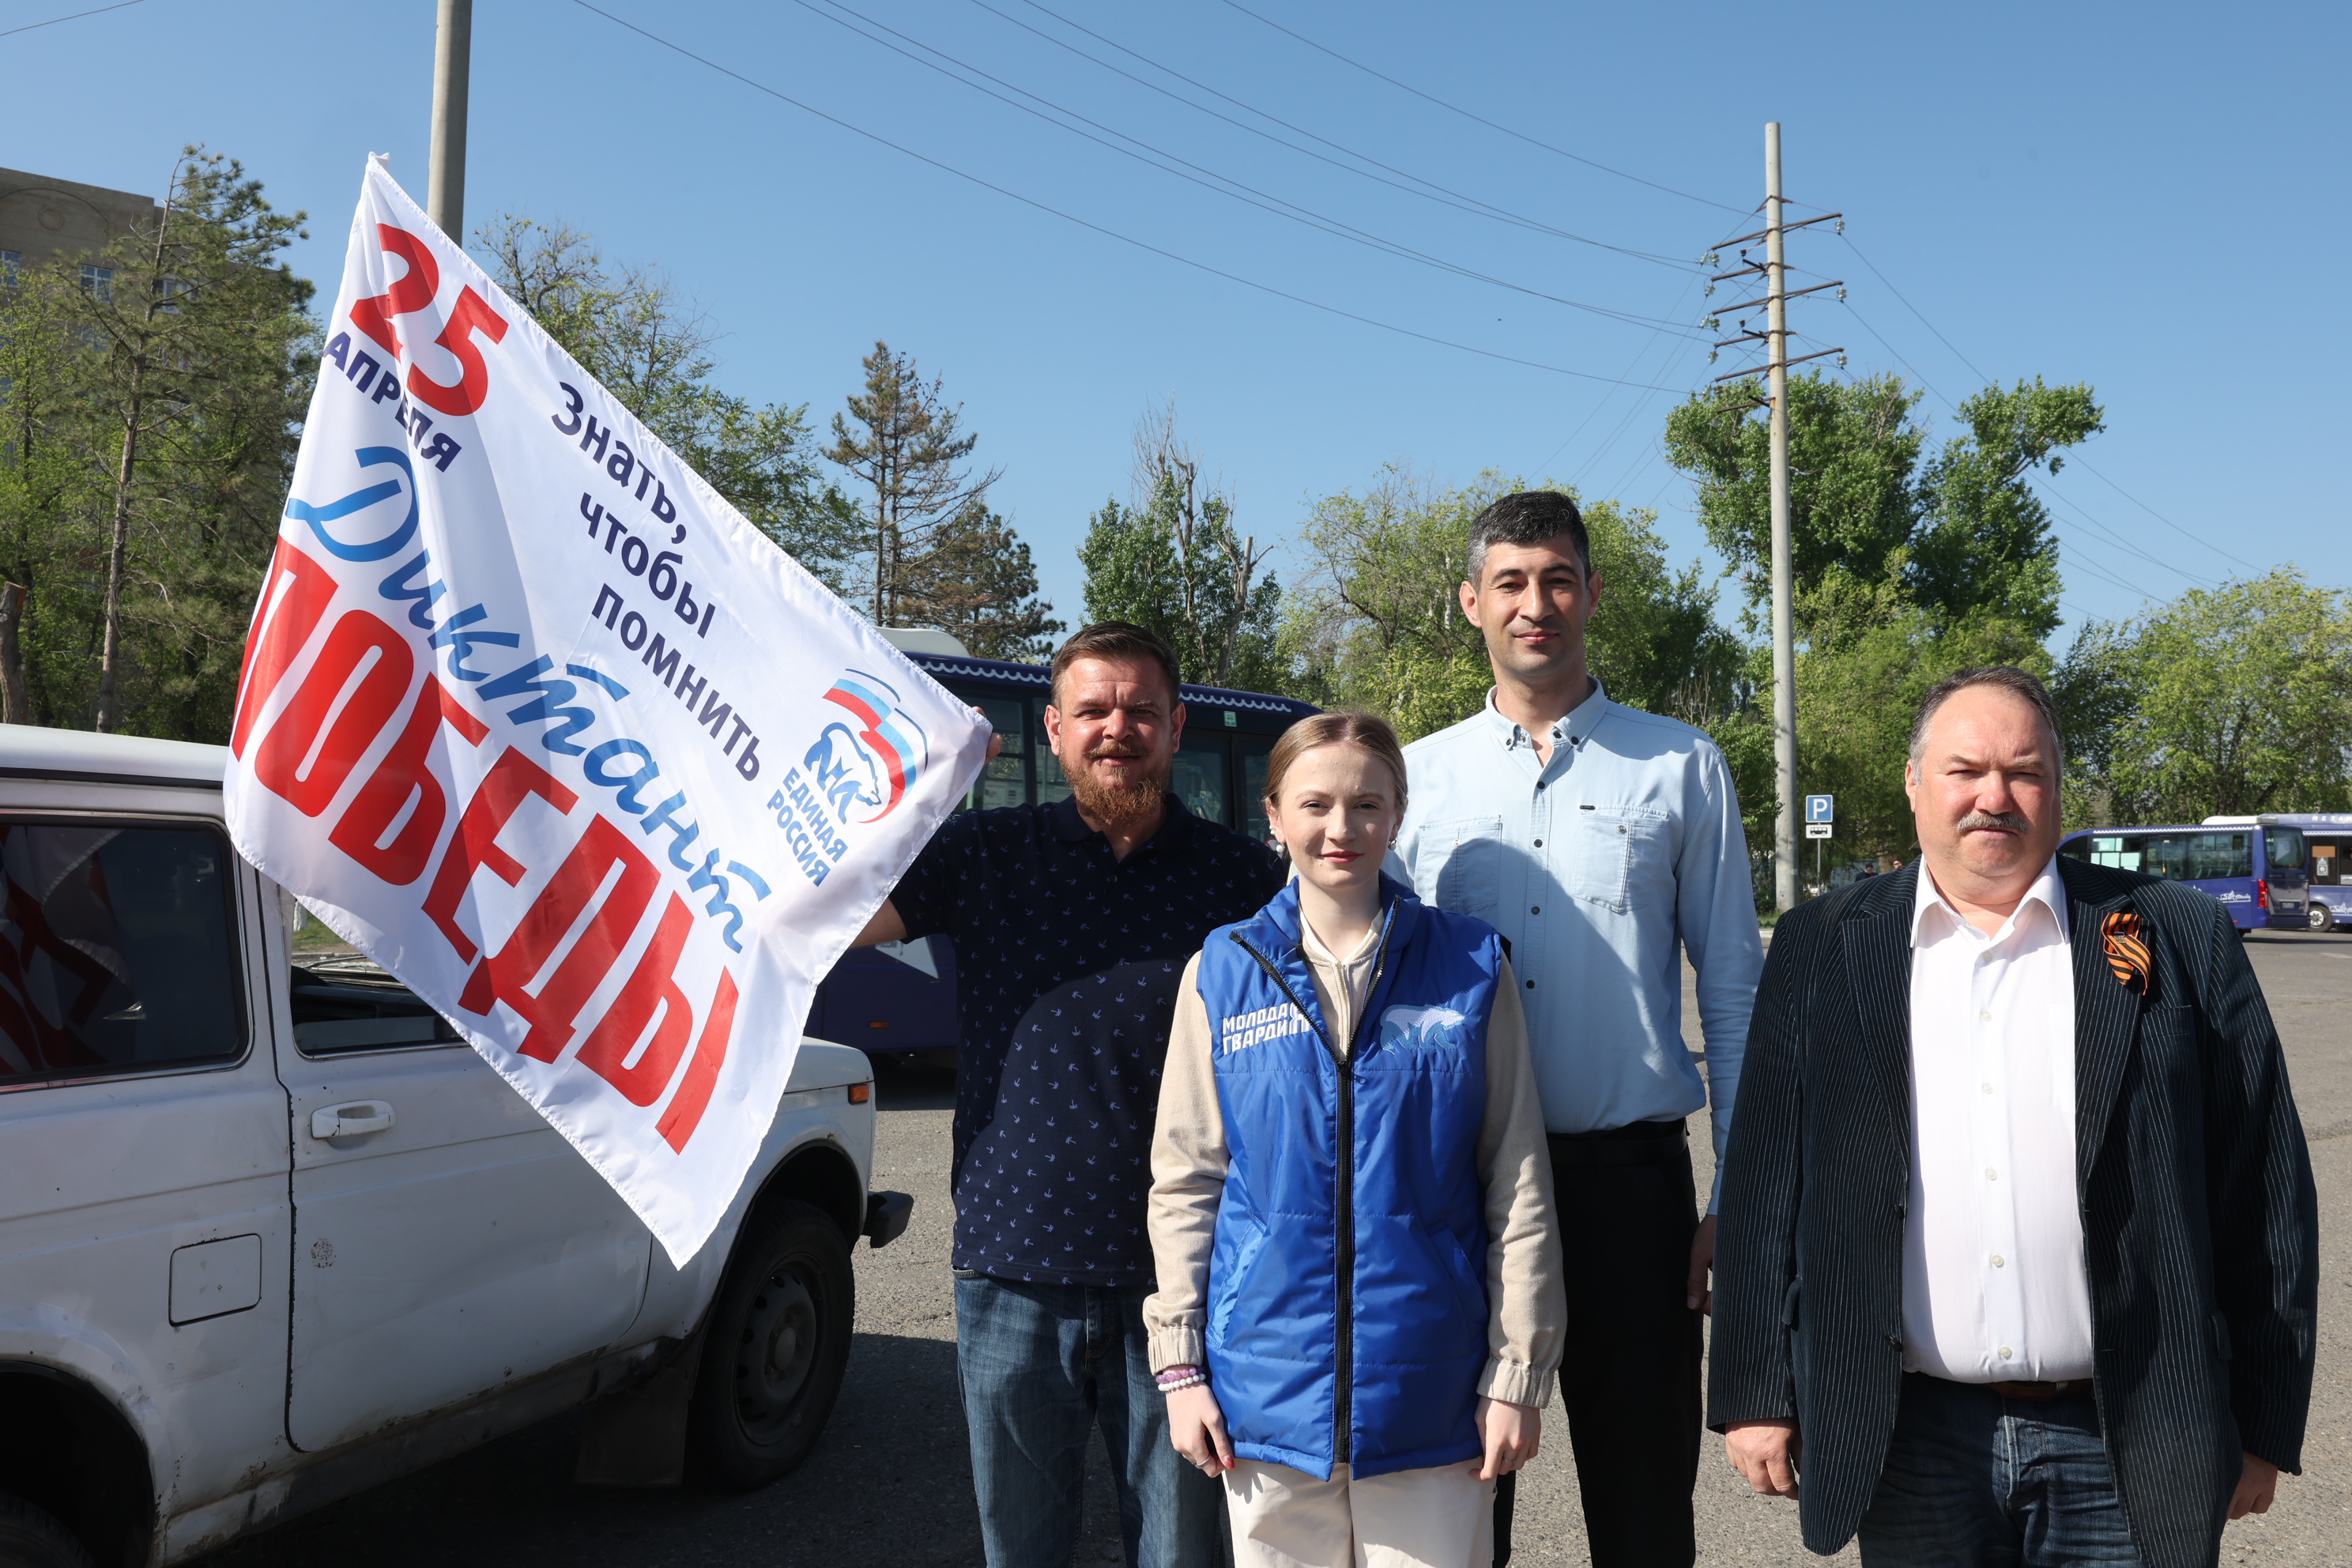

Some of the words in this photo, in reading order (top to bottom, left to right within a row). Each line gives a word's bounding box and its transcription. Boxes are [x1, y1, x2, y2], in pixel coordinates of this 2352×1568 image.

[349, 224, 509, 416] 25
[322, 330, 462, 472] АПРЕЛЯ
[552, 382, 688, 544] Знать,
[579, 492, 716, 639] чтобы
[285, 446, 771, 954] Диктант
[591, 583, 760, 781] помнить
[232, 534, 739, 1155] ПОБЕДЫ
[767, 789, 831, 888] РОССИЯ
[782, 767, 848, 863] ЕДИНАЯ
[1813, 798, 1828, 820] P
